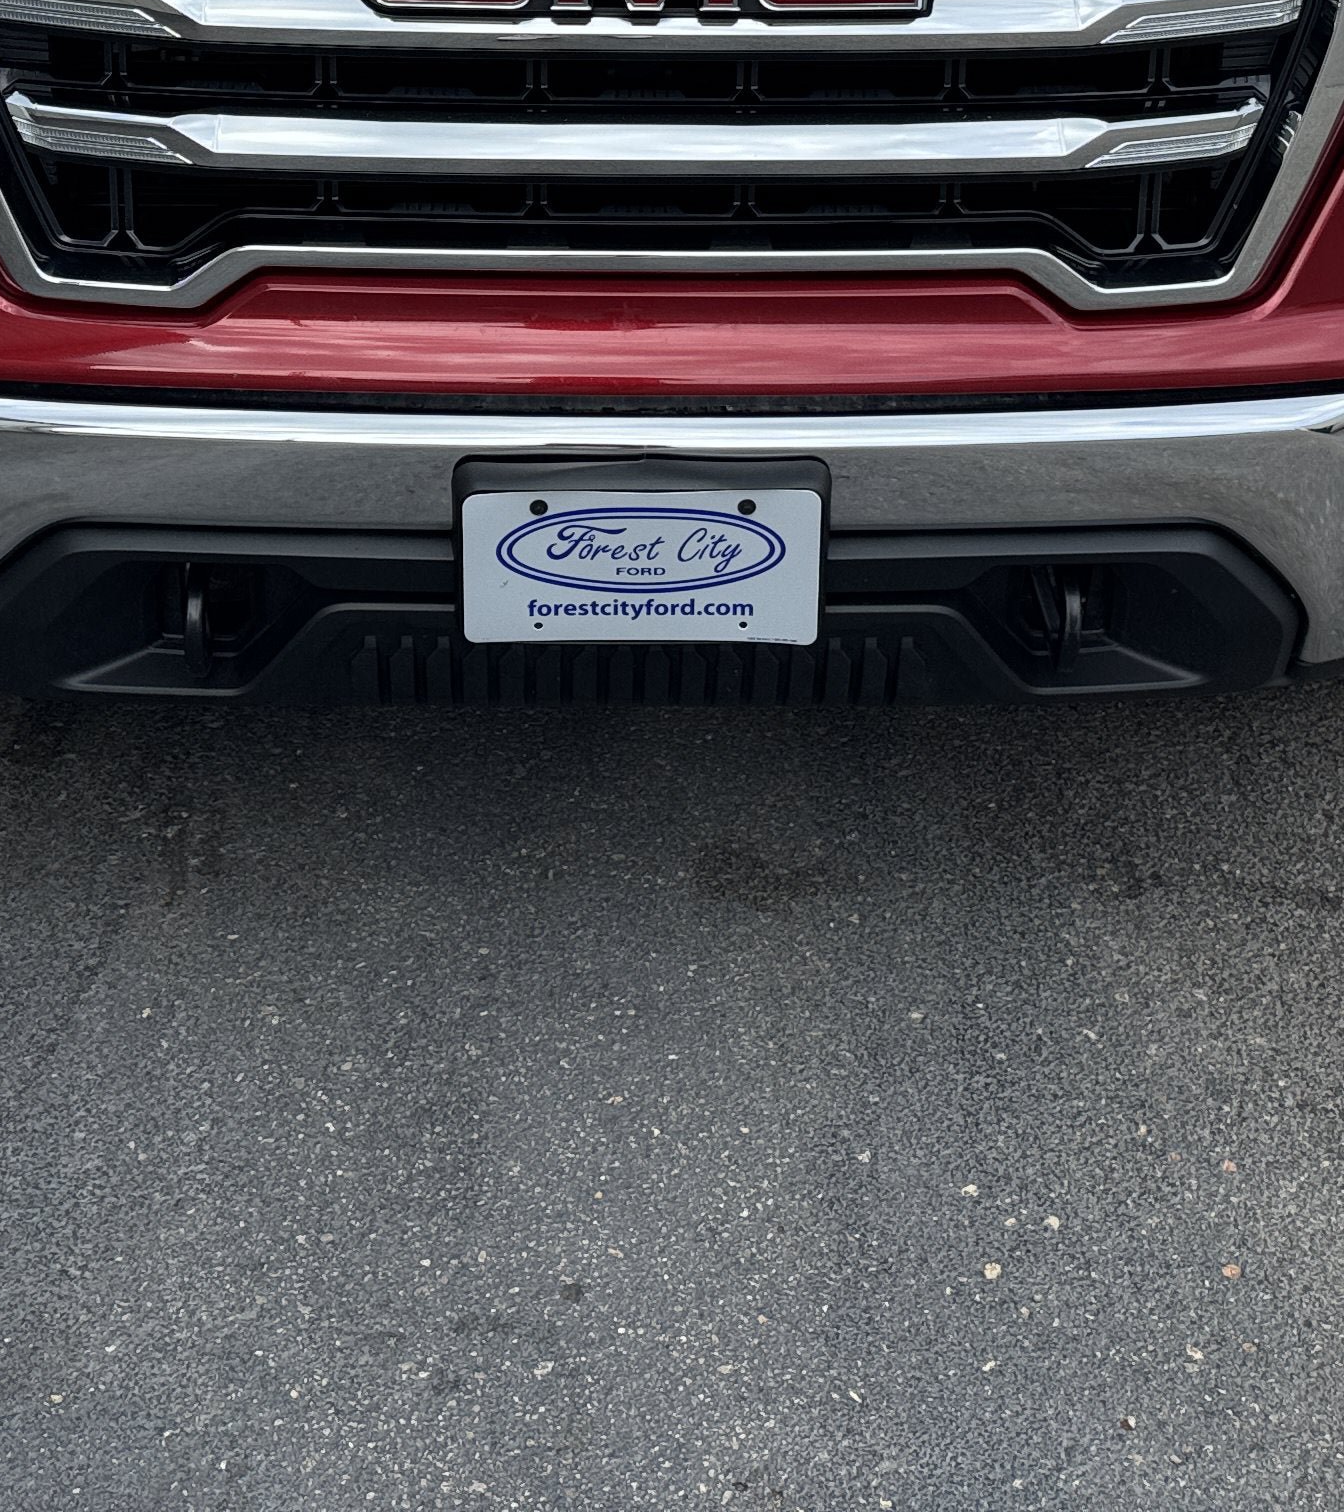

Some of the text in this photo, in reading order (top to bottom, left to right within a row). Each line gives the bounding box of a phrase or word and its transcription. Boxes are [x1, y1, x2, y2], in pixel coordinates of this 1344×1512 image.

[546, 524, 744, 574] Forest City
[615, 567, 666, 576] FORD
[527, 598, 754, 621] forestcityford.com
